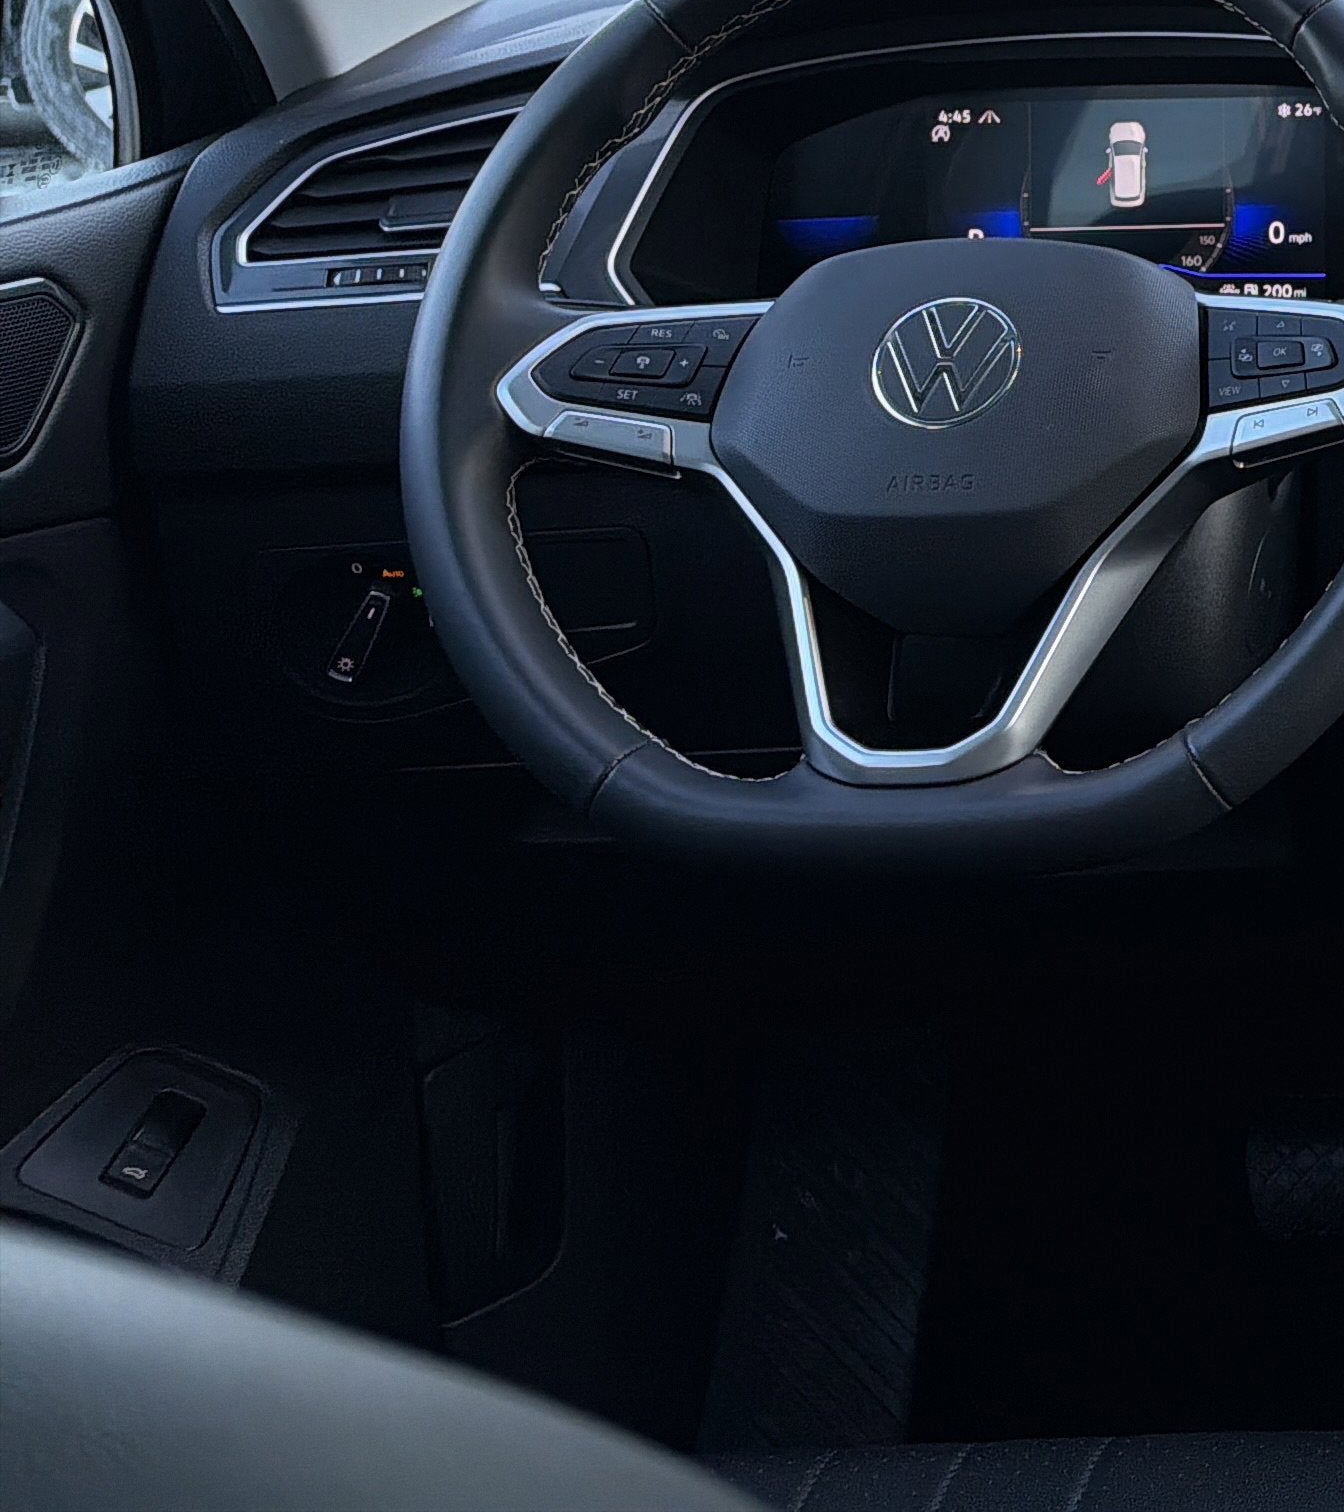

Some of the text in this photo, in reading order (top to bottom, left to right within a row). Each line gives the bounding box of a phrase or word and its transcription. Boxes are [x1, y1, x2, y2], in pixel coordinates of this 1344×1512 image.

[938, 109, 971, 124] 4:45
[1268, 220, 1313, 245] 0 mph
[1180, 255, 1203, 268] 160
[650, 328, 673, 338] RES
[1272, 346, 1288, 357] OK
[616, 389, 639, 400] SET
[1218, 386, 1242, 397] VIEW
[886, 473, 974, 493] AIRBAG
